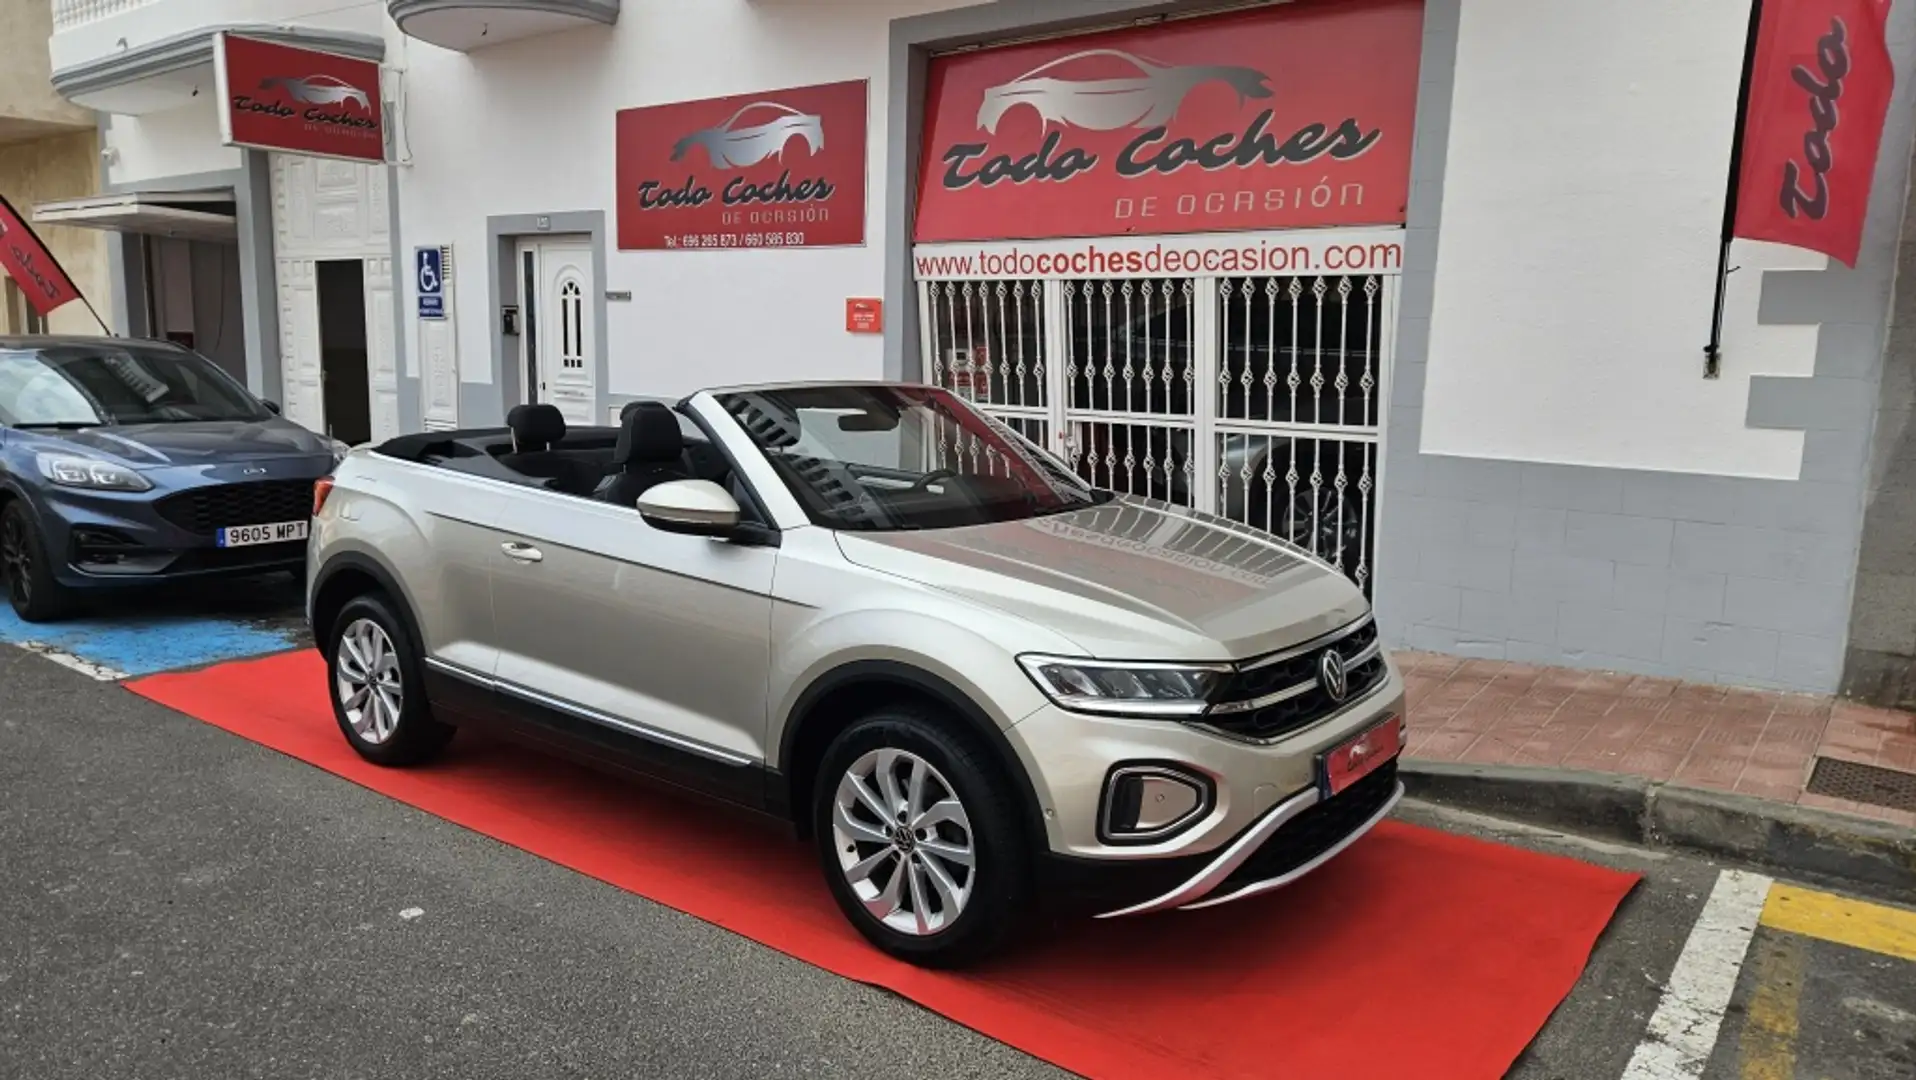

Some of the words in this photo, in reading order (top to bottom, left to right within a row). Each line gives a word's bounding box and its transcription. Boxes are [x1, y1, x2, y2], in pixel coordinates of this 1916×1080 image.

[233, 95, 296, 119] Todo
[303, 107, 378, 129] Coches
[1779, 15, 1850, 220] Todo
[942, 130, 1099, 191] Todo
[1115, 108, 1382, 179] Coches
[638, 175, 715, 211] Todo
[722, 168, 836, 206] Coches
[1115, 196, 1159, 219] DE
[1177, 176, 1364, 215] OCASIÓN
[722, 211, 742, 225] DE
[750, 204, 829, 224] OCASIÓN
[916, 239, 1401, 276] www.todocochesdeocasion.com
[230, 525, 271, 544] 9605
[277, 522, 306, 539] MPT
